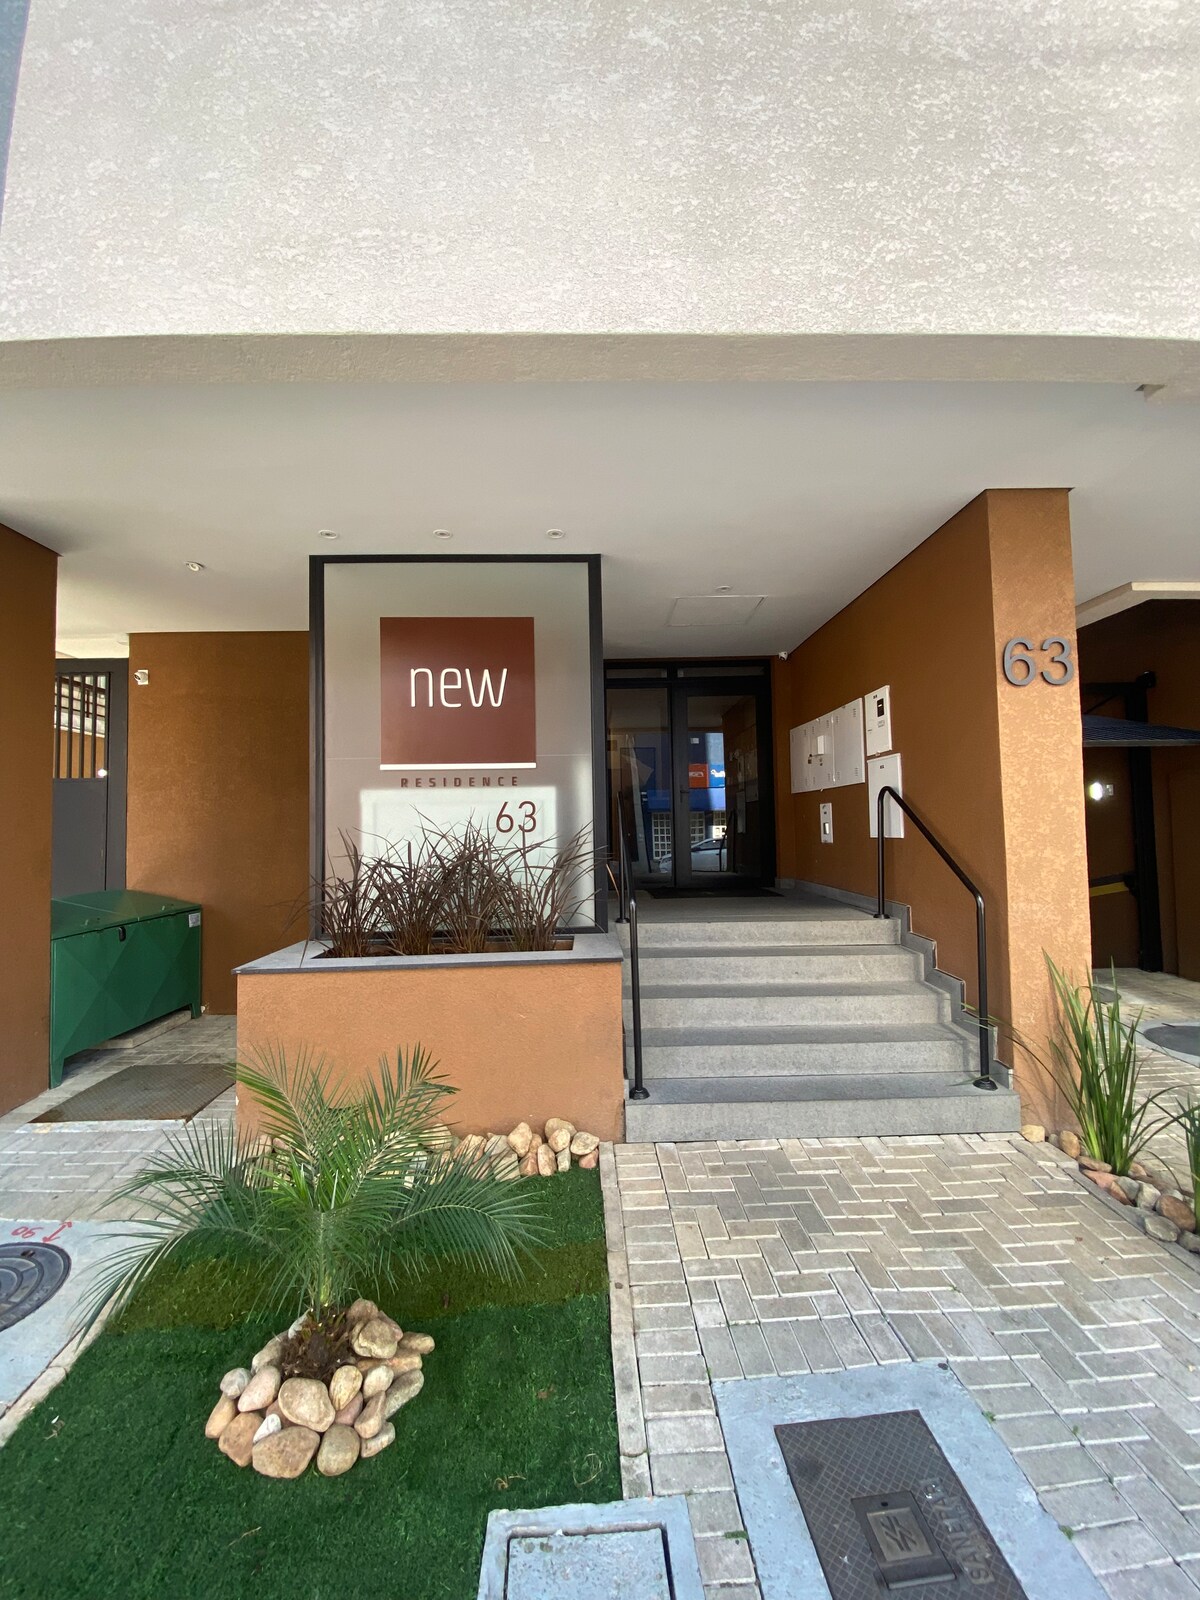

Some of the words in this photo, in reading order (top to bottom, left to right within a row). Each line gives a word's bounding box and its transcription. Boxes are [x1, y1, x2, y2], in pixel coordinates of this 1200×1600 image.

[1003, 637, 1074, 686] 63
[410, 668, 507, 708] new
[400, 776, 518, 788] RESIDENCE
[496, 801, 537, 833] 63
